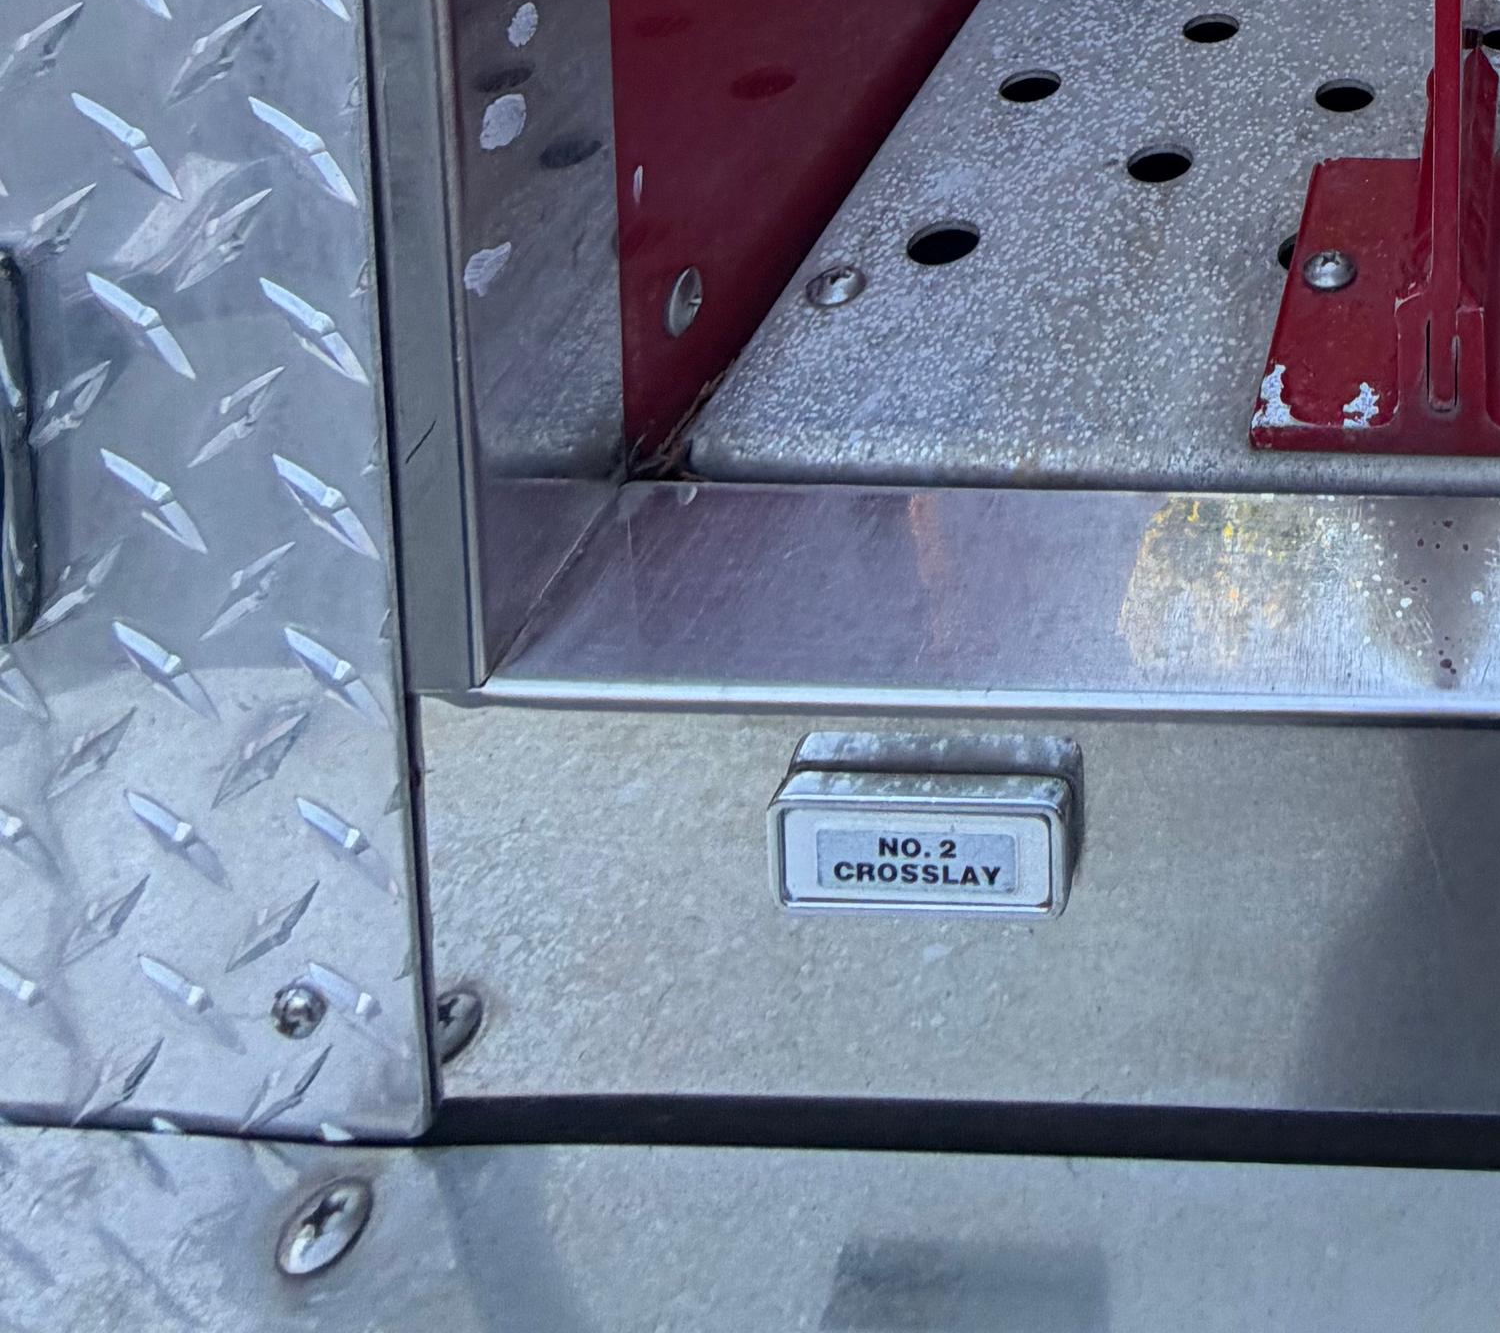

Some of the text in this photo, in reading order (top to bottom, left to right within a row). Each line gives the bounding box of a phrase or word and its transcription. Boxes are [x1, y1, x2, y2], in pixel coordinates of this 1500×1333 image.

[878, 837, 957, 859] NO. 2
[833, 861, 1001, 886] CROSSLAY
